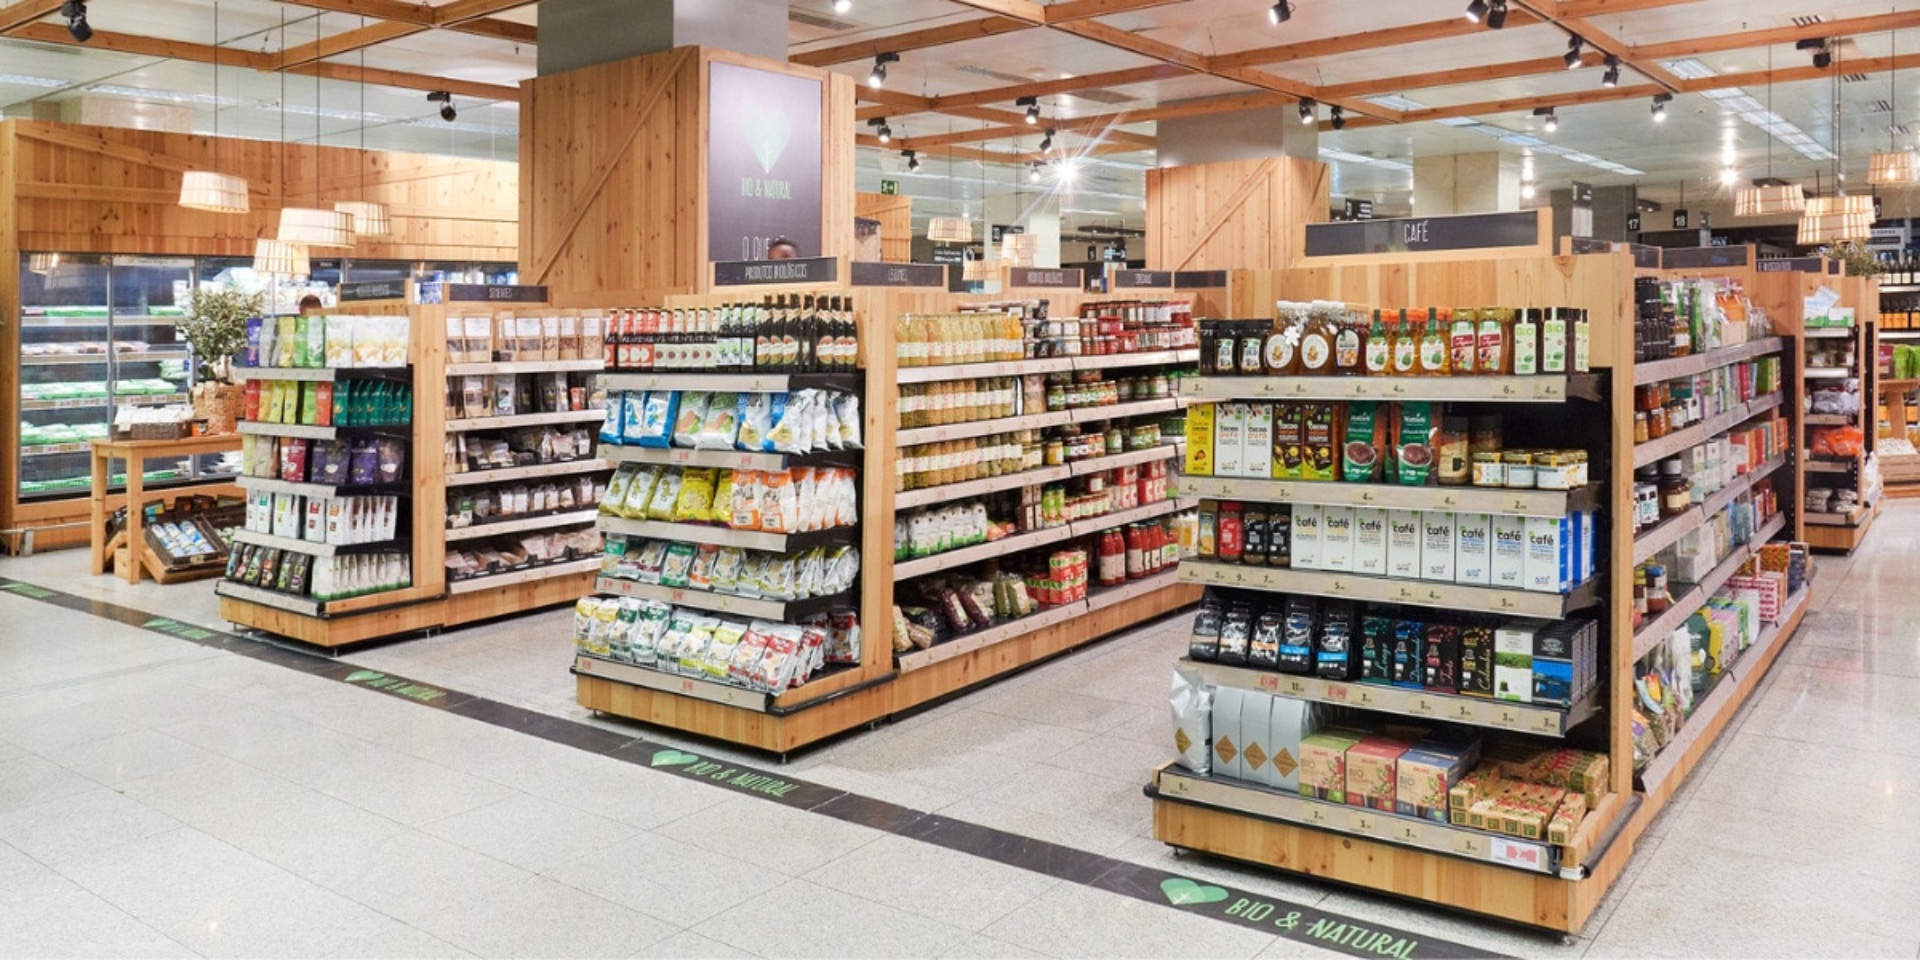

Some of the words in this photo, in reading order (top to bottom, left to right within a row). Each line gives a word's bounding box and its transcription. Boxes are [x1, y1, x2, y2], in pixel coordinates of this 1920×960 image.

[1628, 218, 1639, 230] 17
[1675, 215, 1686, 227] 18
[1404, 221, 1429, 243] CAFÉ
[1225, 898, 1275, 922] BIO
[1275, 912, 1302, 930] &
[1306, 918, 1418, 960] NATURAL
